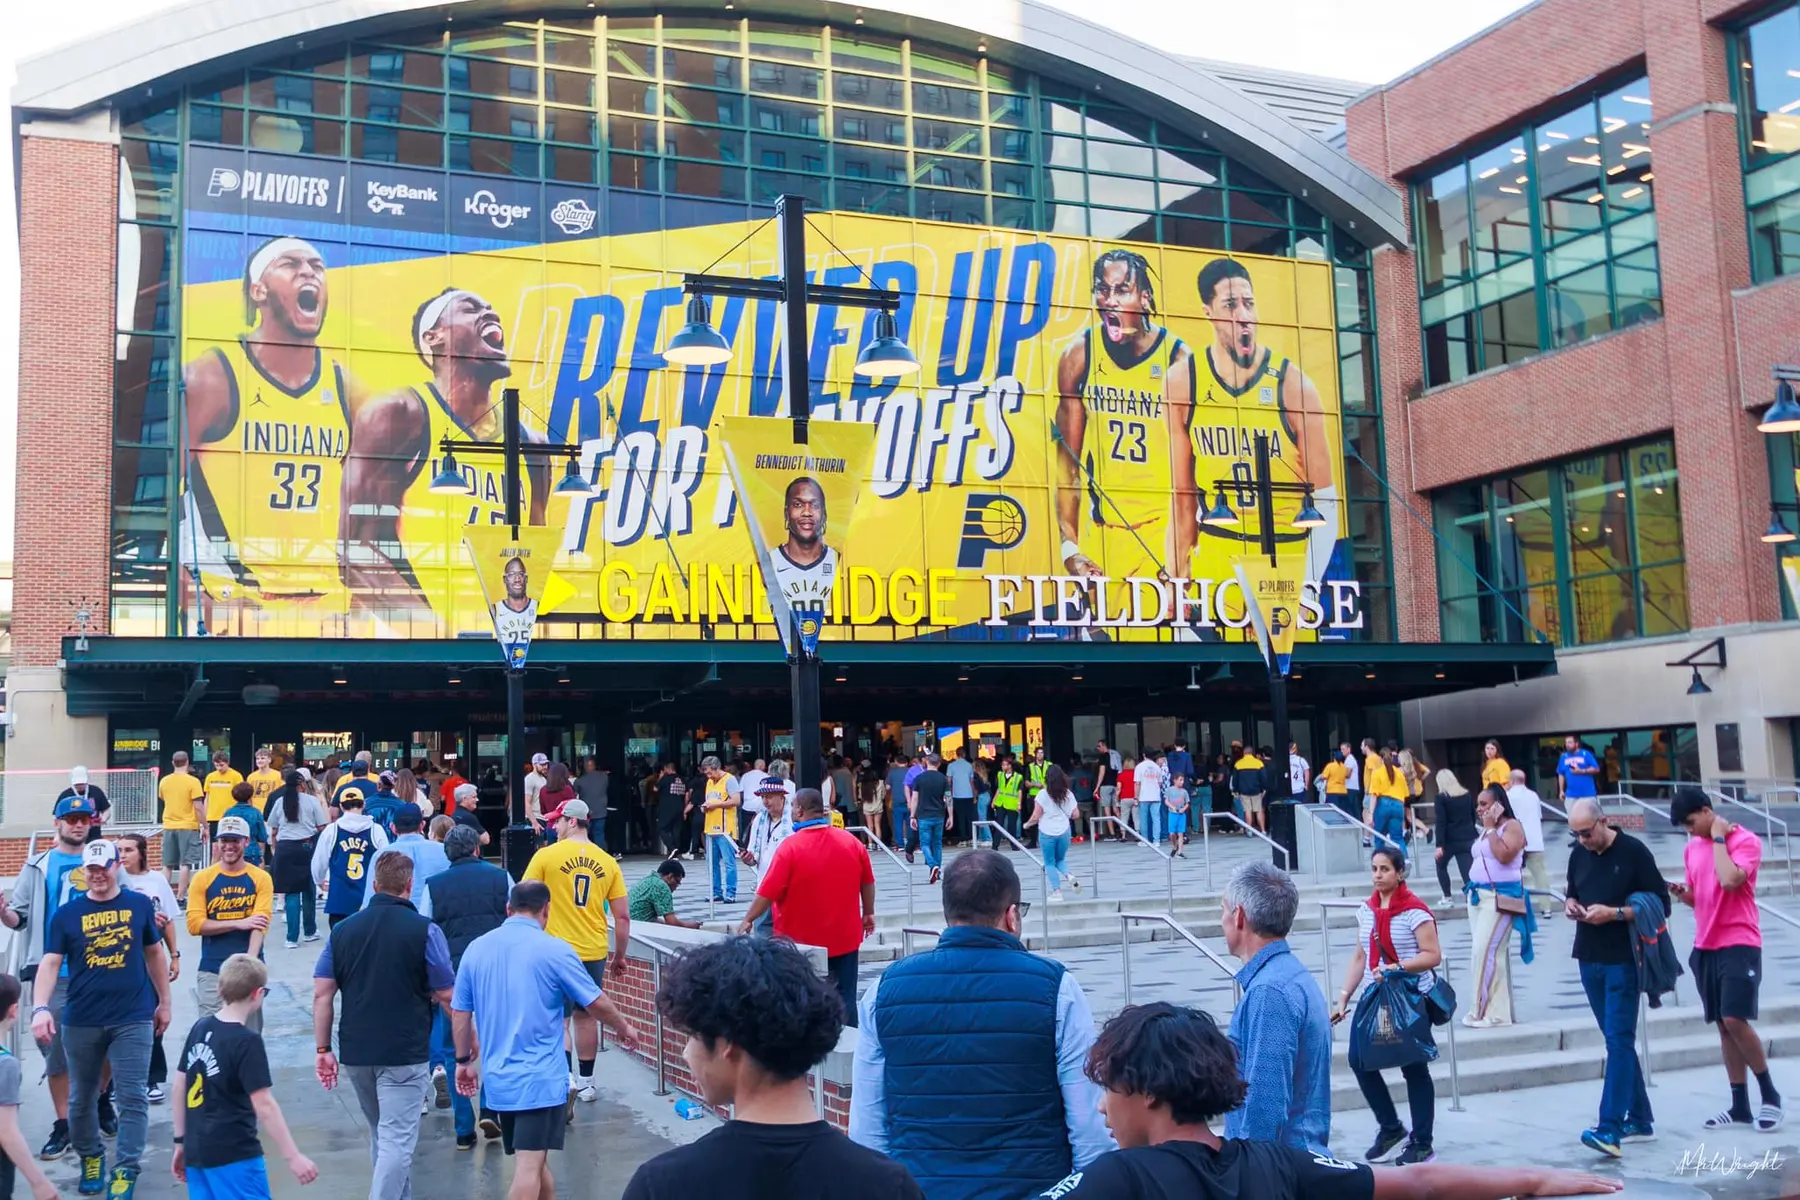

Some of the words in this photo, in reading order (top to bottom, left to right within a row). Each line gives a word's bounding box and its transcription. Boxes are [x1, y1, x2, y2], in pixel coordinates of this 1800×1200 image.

[241, 169, 330, 207] PLAYOFFS
[367, 181, 438, 202] KeyBank
[465, 192, 531, 228] Kroger
[553, 203, 596, 230] Starry
[547, 260, 917, 442] REVVED
[936, 242, 1056, 387] UP
[1087, 385, 1162, 420] INDIANA
[243, 420, 345, 459] INDIANA
[1108, 420, 1148, 463] 23
[1194, 427, 1282, 458] INDIAA
[755, 454, 803, 470] BENNEDICT
[805, 456, 846, 473] MATHURIN
[269, 461, 323, 512] 33
[560, 426, 708, 554] FOR
[984, 574, 1364, 629] FIELDHOSE
[1268, 580, 1295, 592] PLAYOFFS
[340, 837, 368, 852] ROSE
[346, 853, 364, 880] 5
[560, 856, 606, 880] HALIBURTON
[574, 874, 591, 907] 0
[82, 910, 118, 933] REVVED
[119, 909, 132, 922] UP
